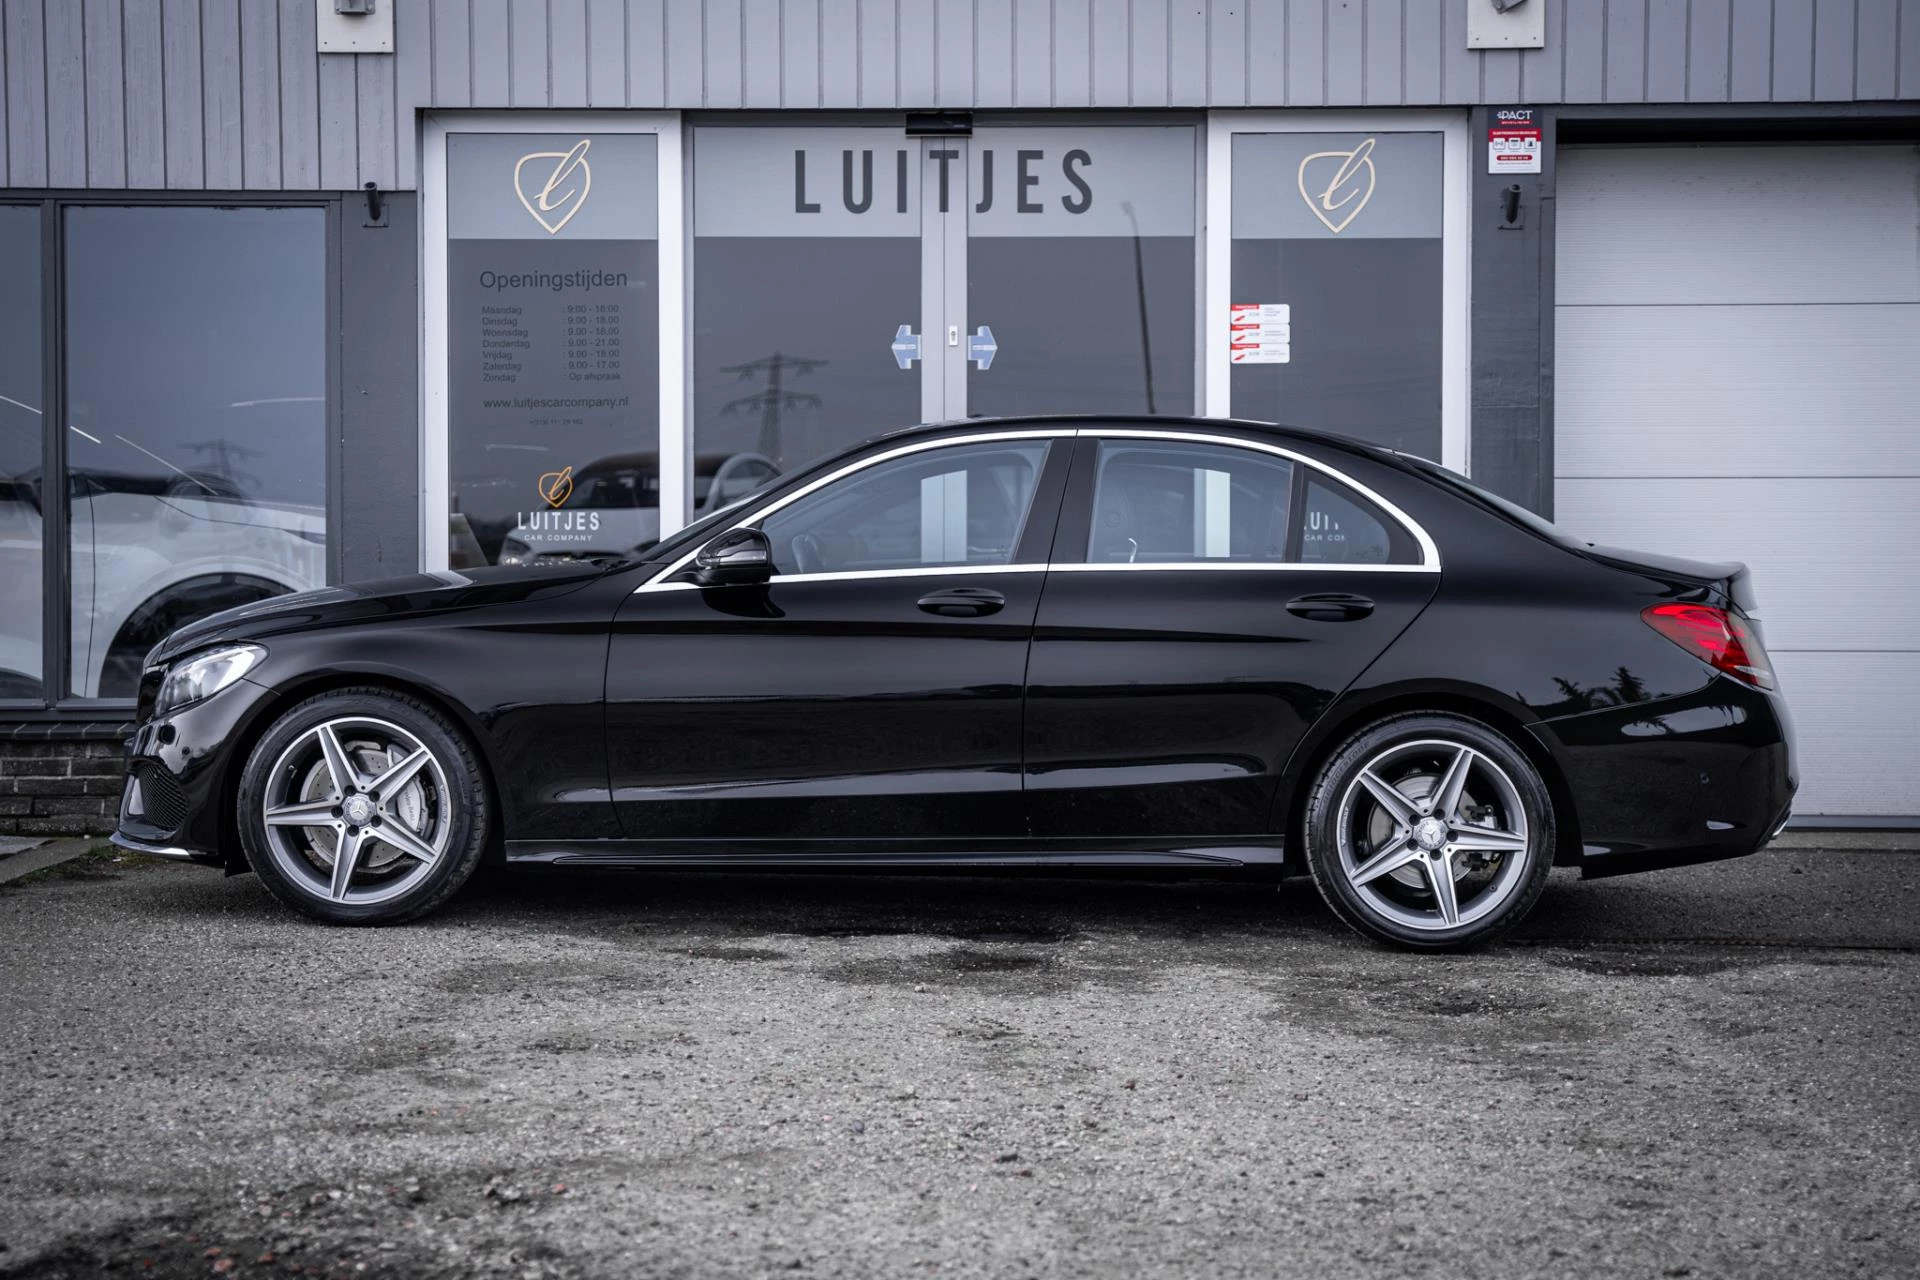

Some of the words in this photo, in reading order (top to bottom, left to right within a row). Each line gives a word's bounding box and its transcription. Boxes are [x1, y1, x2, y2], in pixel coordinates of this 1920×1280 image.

[795, 149, 1093, 215] LUITJES
[480, 270, 628, 292] Openingstijden
[482, 329, 529, 338] Woensdag
[482, 396, 630, 410] www.luitjescarcompany.nl
[517, 511, 600, 531] LUITJES
